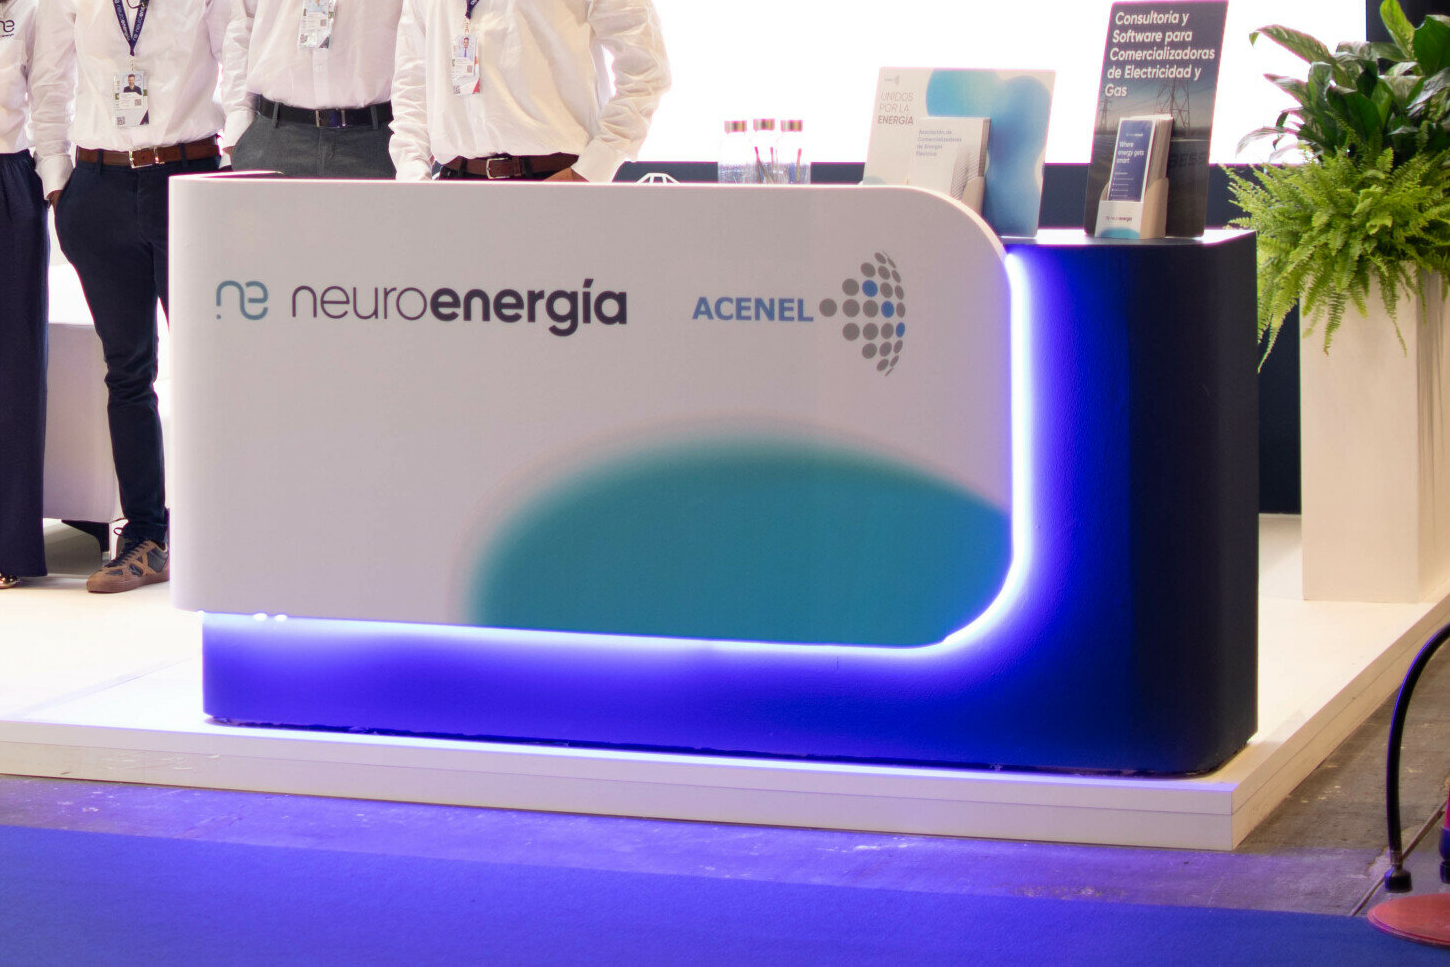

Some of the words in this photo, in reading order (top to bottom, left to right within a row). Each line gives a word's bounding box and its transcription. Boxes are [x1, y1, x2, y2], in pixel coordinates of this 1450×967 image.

[1181, 13, 1190, 26] y
[1112, 29, 1162, 43] Software
[1164, 31, 1193, 45] para
[1110, 46, 1215, 60] Comercializadoras
[1107, 65, 1122, 79] de
[1124, 64, 1192, 79] Electricidad
[1194, 67, 1202, 81] y
[881, 92, 914, 102] UNIDOS
[1105, 83, 1127, 97] Gas
[879, 103, 897, 113] POR
[899, 104, 909, 113] LA
[878, 114, 914, 125] ENERGÍA
[291, 278, 628, 337] neuroenergía
[692, 296, 815, 322] ACENEL
